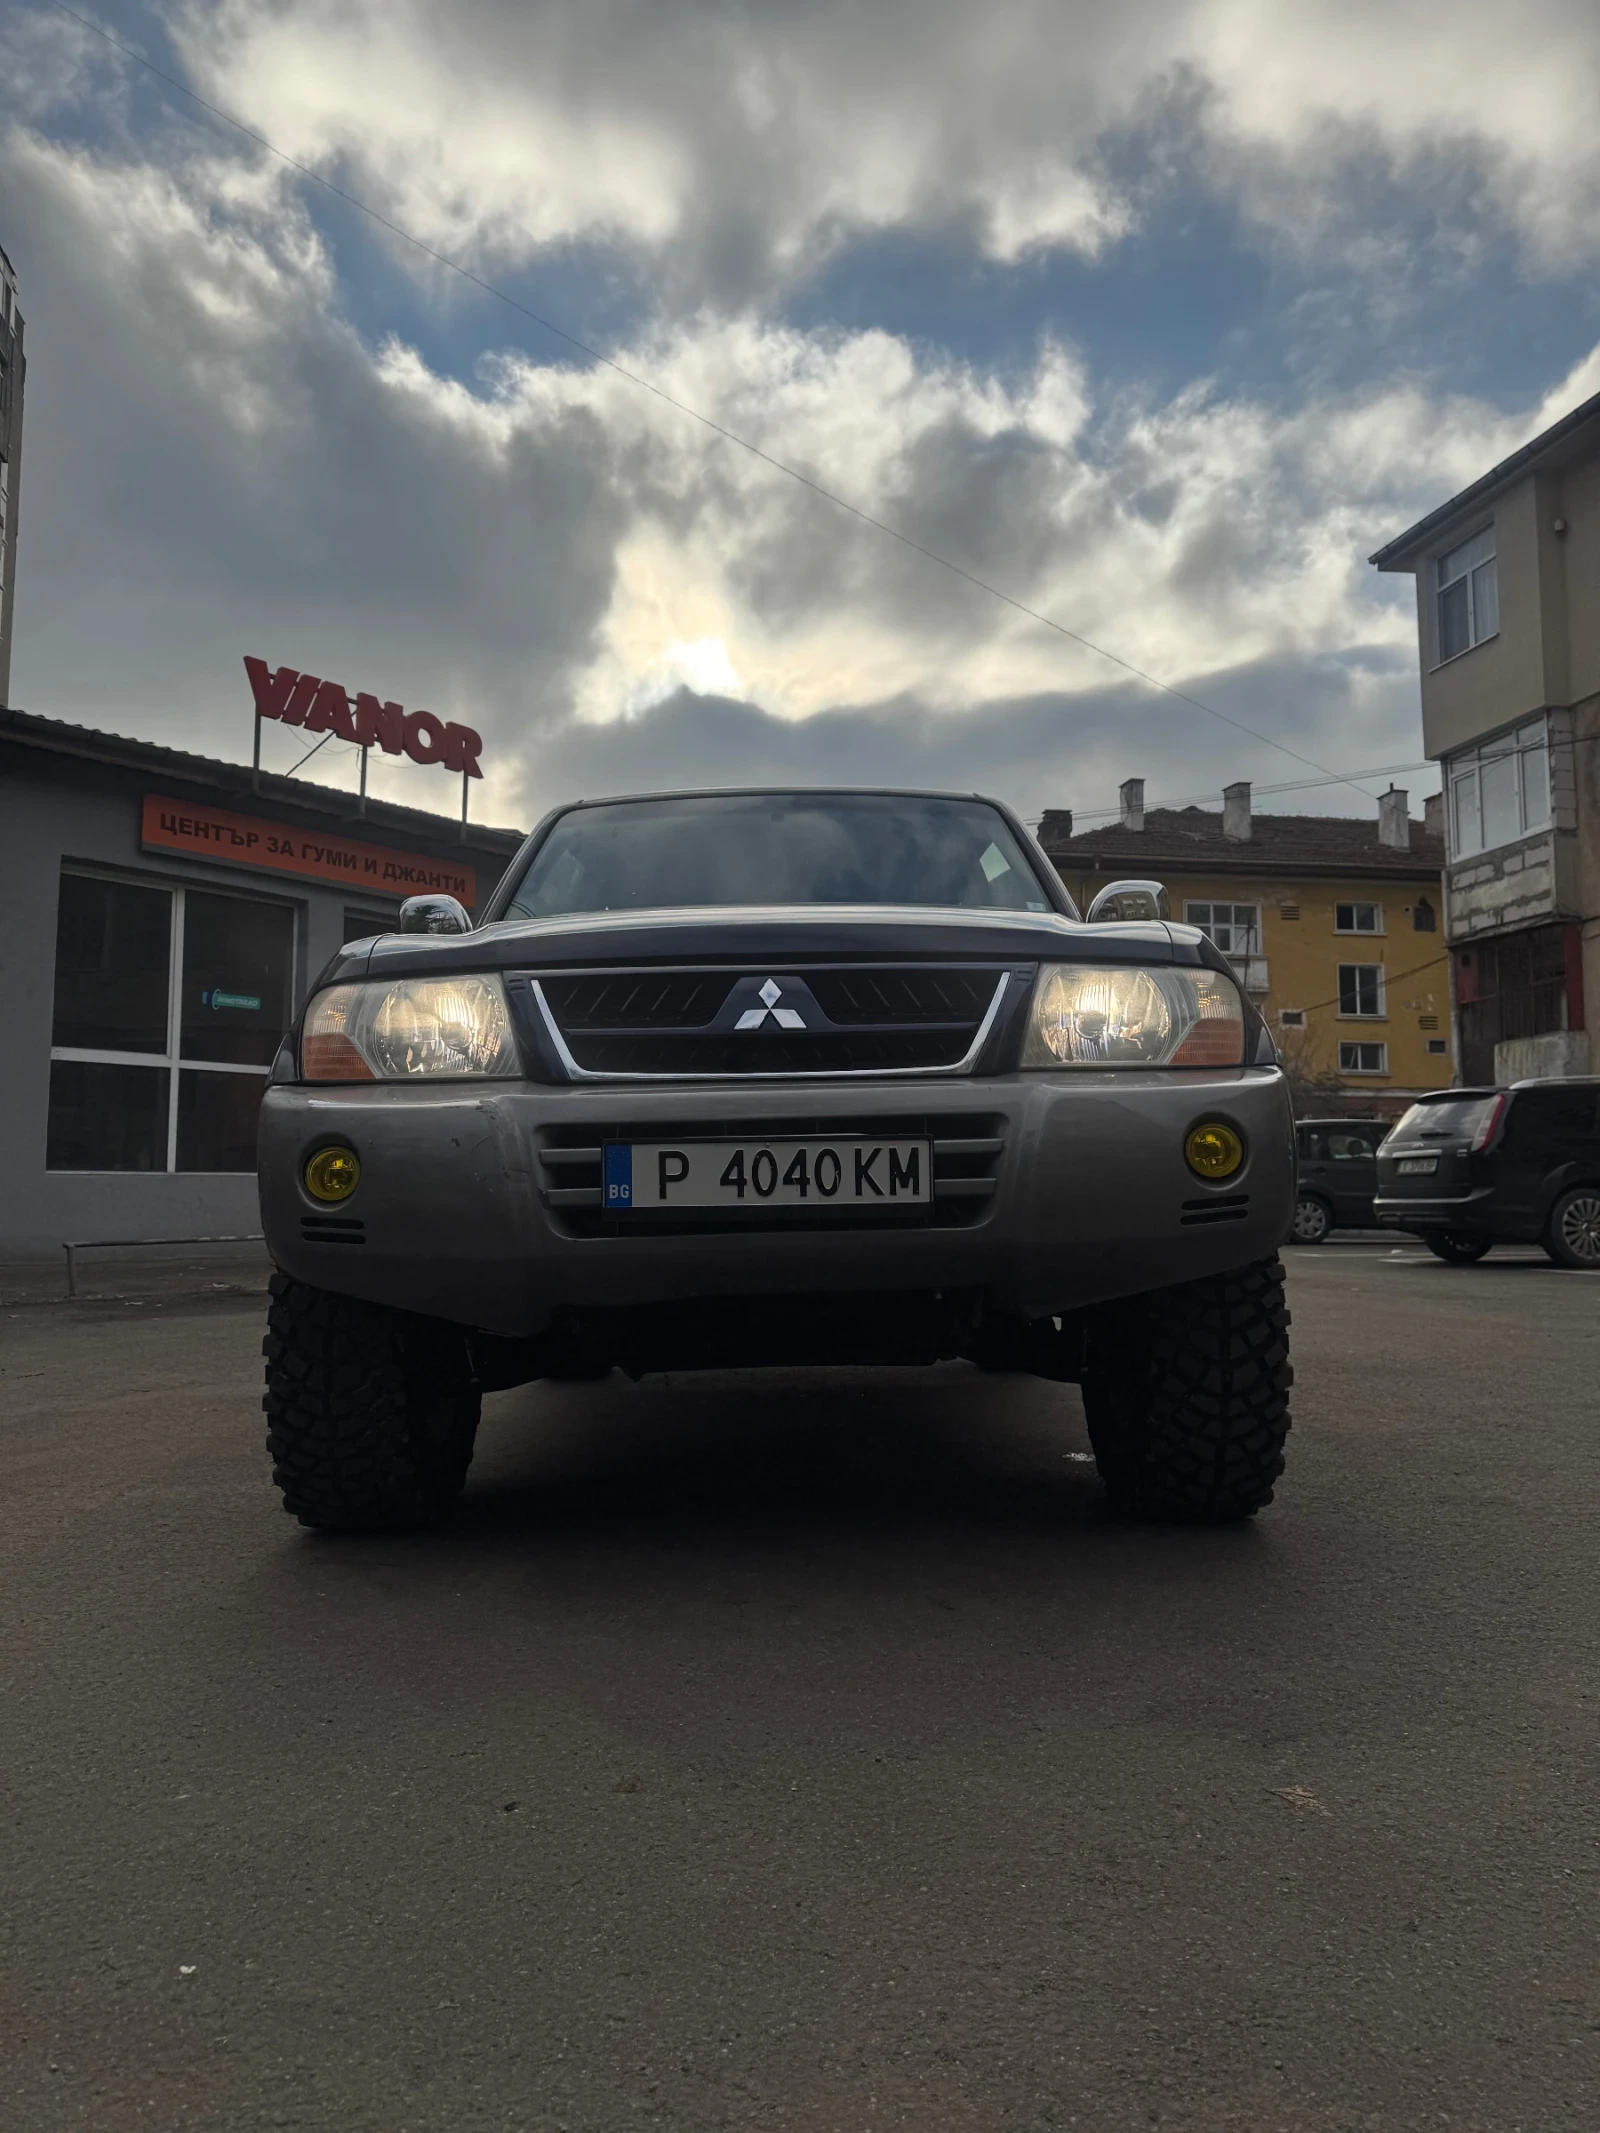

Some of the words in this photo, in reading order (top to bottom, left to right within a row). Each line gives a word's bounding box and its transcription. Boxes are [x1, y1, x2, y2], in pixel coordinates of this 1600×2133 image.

[243, 655, 484, 779] VIANOR
[159, 813, 260, 849] ЦЕНТЪР
[266, 836, 295, 858] ЗА
[301, 843, 358, 870] ГУМИ
[363, 858, 378, 875] И
[382, 862, 467, 893] ДЖАНТИ
[608, 1184, 630, 1199] BG
[658, 1150, 690, 1199] P
[719, 1147, 842, 1198] 4040
[854, 1146, 920, 1196] KM
